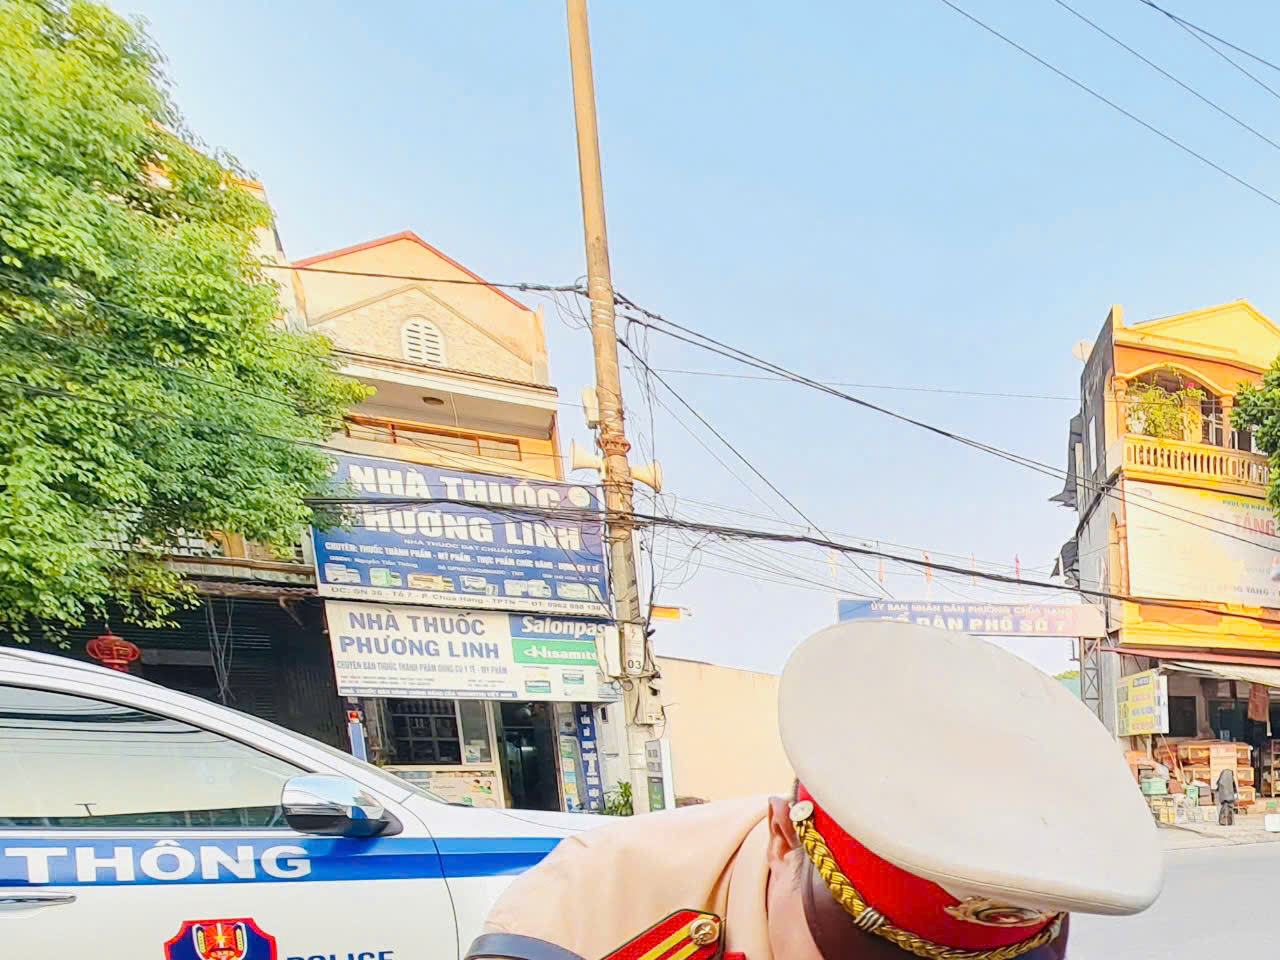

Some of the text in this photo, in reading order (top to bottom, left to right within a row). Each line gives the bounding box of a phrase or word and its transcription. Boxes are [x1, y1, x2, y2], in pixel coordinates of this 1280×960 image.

[348, 464, 432, 499] NHÀ
[350, 504, 581, 550] HƯƠNG LINH
[348, 607, 399, 631] NHÀ
[406, 612, 486, 636] THUỐC
[339, 634, 500, 659] PHƯƠNG LINH
[5, 839, 313, 884] THÔNG
